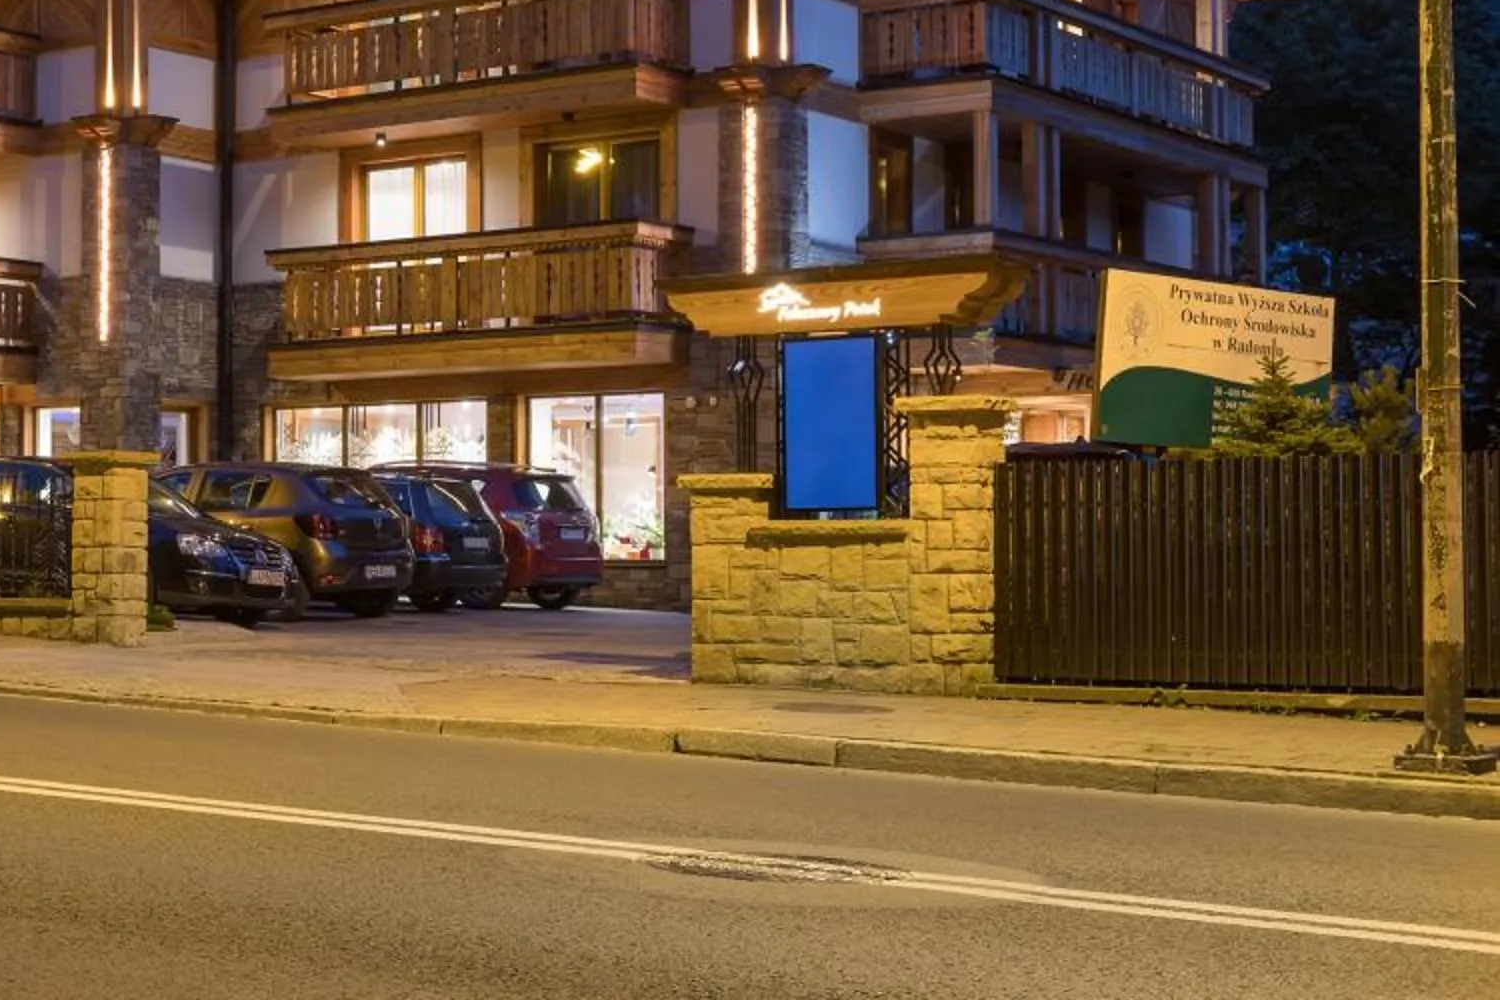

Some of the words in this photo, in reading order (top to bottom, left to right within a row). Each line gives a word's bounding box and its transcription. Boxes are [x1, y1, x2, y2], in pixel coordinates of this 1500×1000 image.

[1170, 283, 1235, 305] Prywatna
[1238, 291, 1285, 313] Wyższa
[1181, 308, 1241, 333] Ochrony
[1213, 339, 1224, 350] w
[1227, 337, 1285, 357] Radomu
